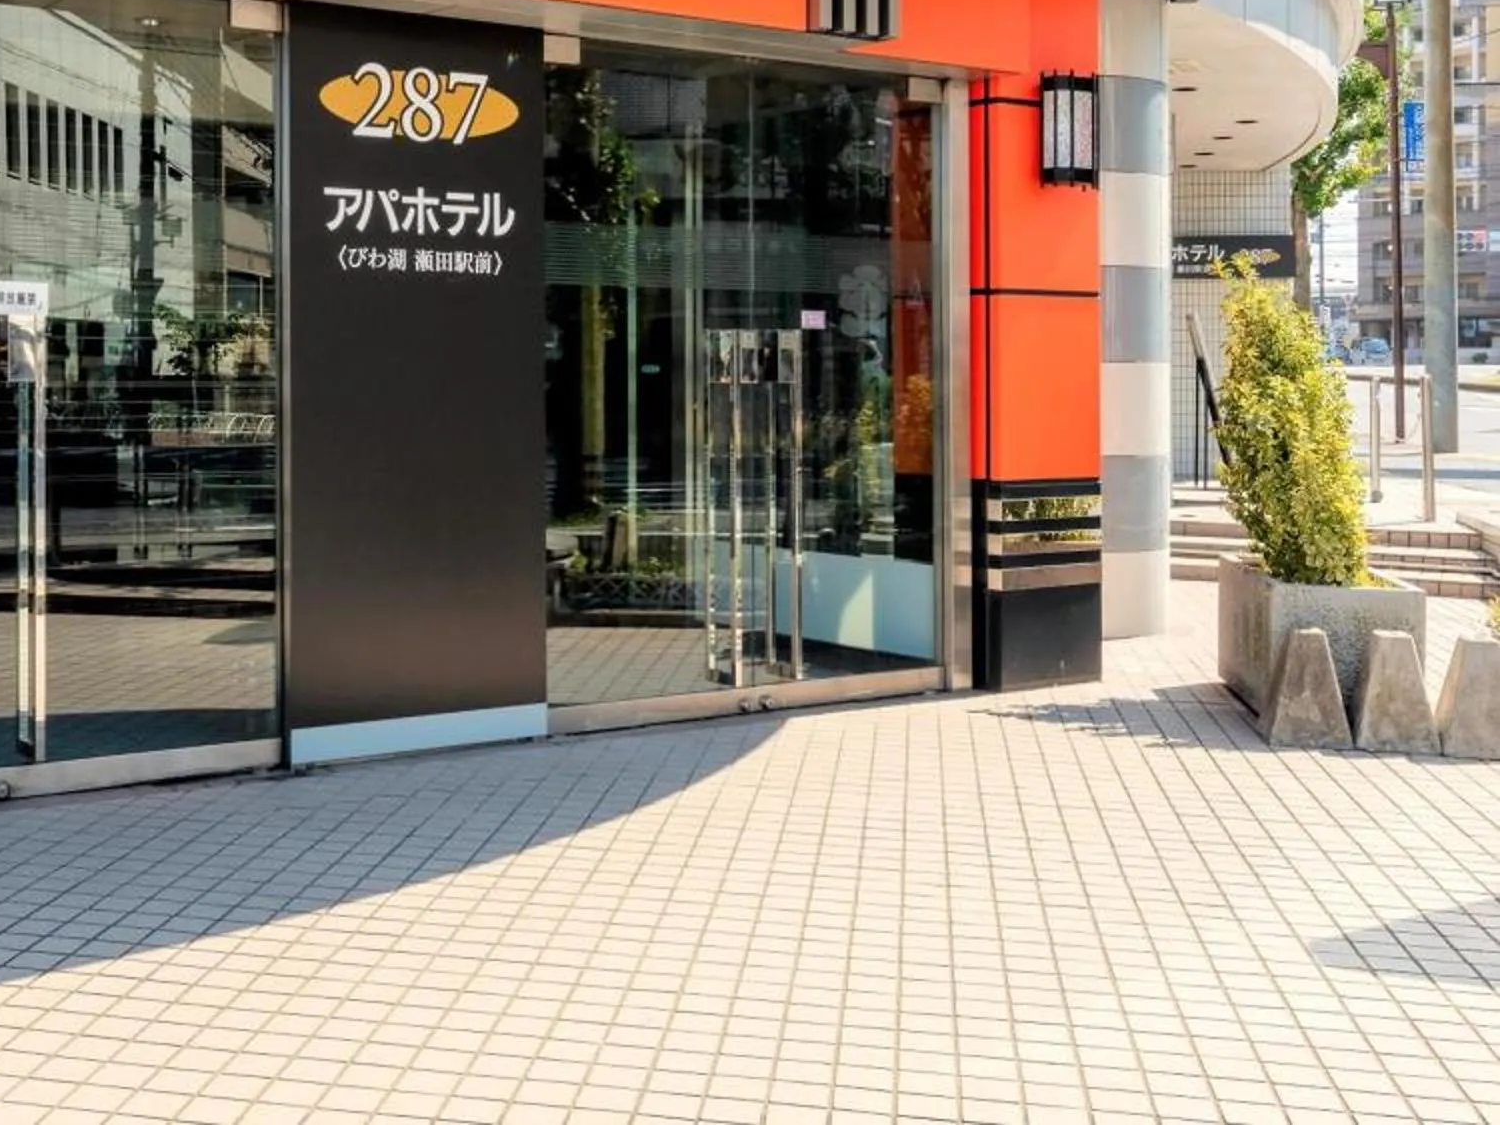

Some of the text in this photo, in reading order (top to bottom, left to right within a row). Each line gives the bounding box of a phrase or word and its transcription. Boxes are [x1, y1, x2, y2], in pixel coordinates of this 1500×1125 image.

[352, 61, 489, 145] 287
[322, 186, 516, 237] アパホテル
